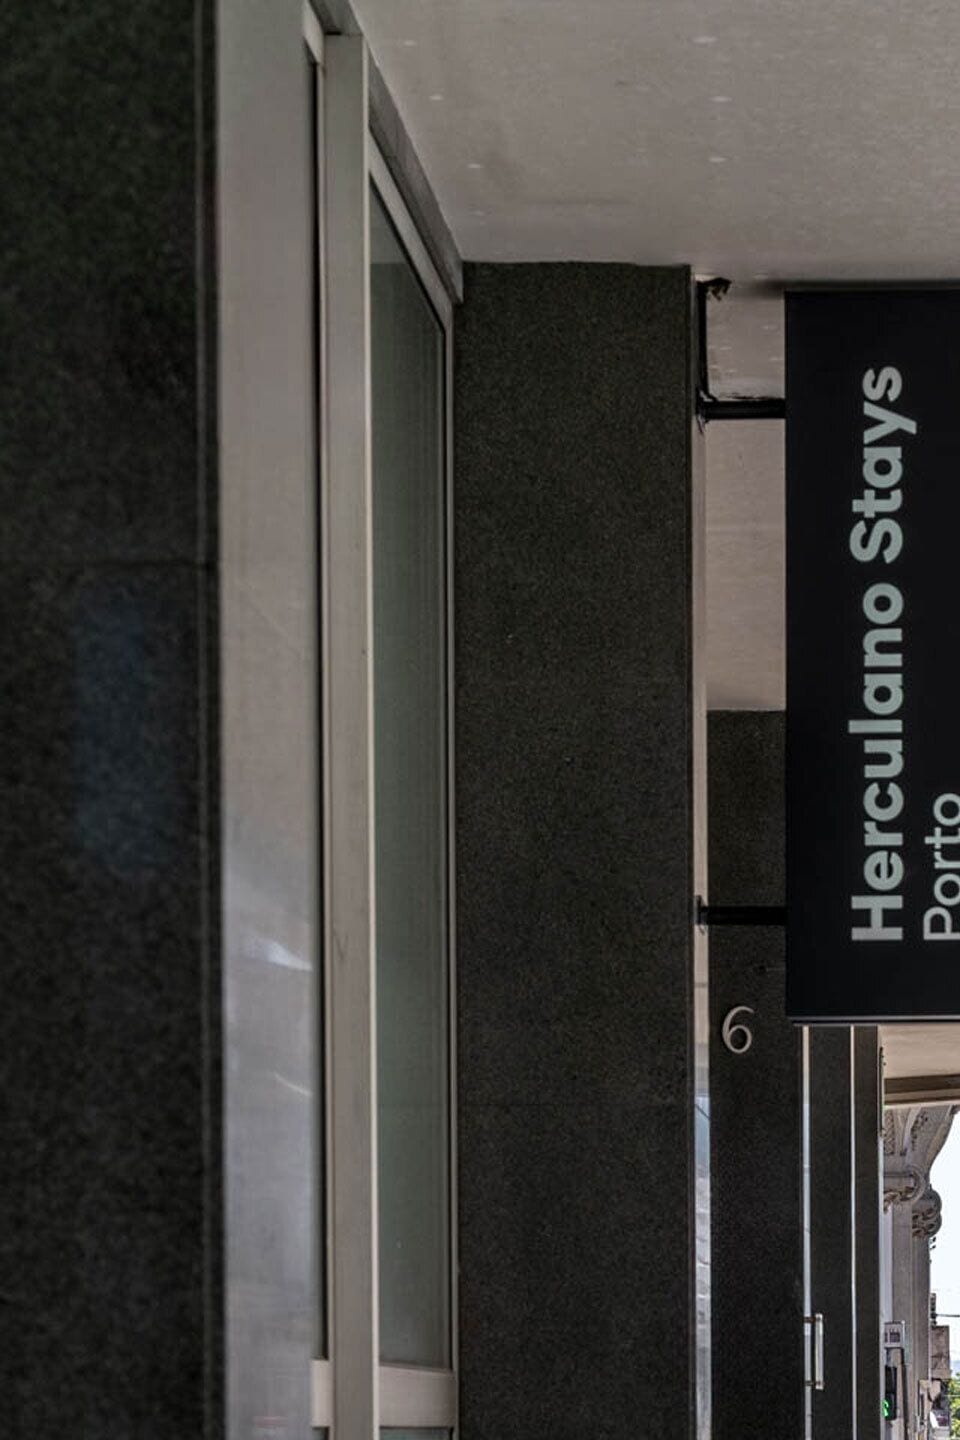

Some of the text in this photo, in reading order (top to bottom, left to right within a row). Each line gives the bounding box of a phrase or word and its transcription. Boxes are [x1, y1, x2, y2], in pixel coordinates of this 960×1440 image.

[848, 366, 917, 941] Herculano Stays
[721, 1006, 754, 1054] 6
